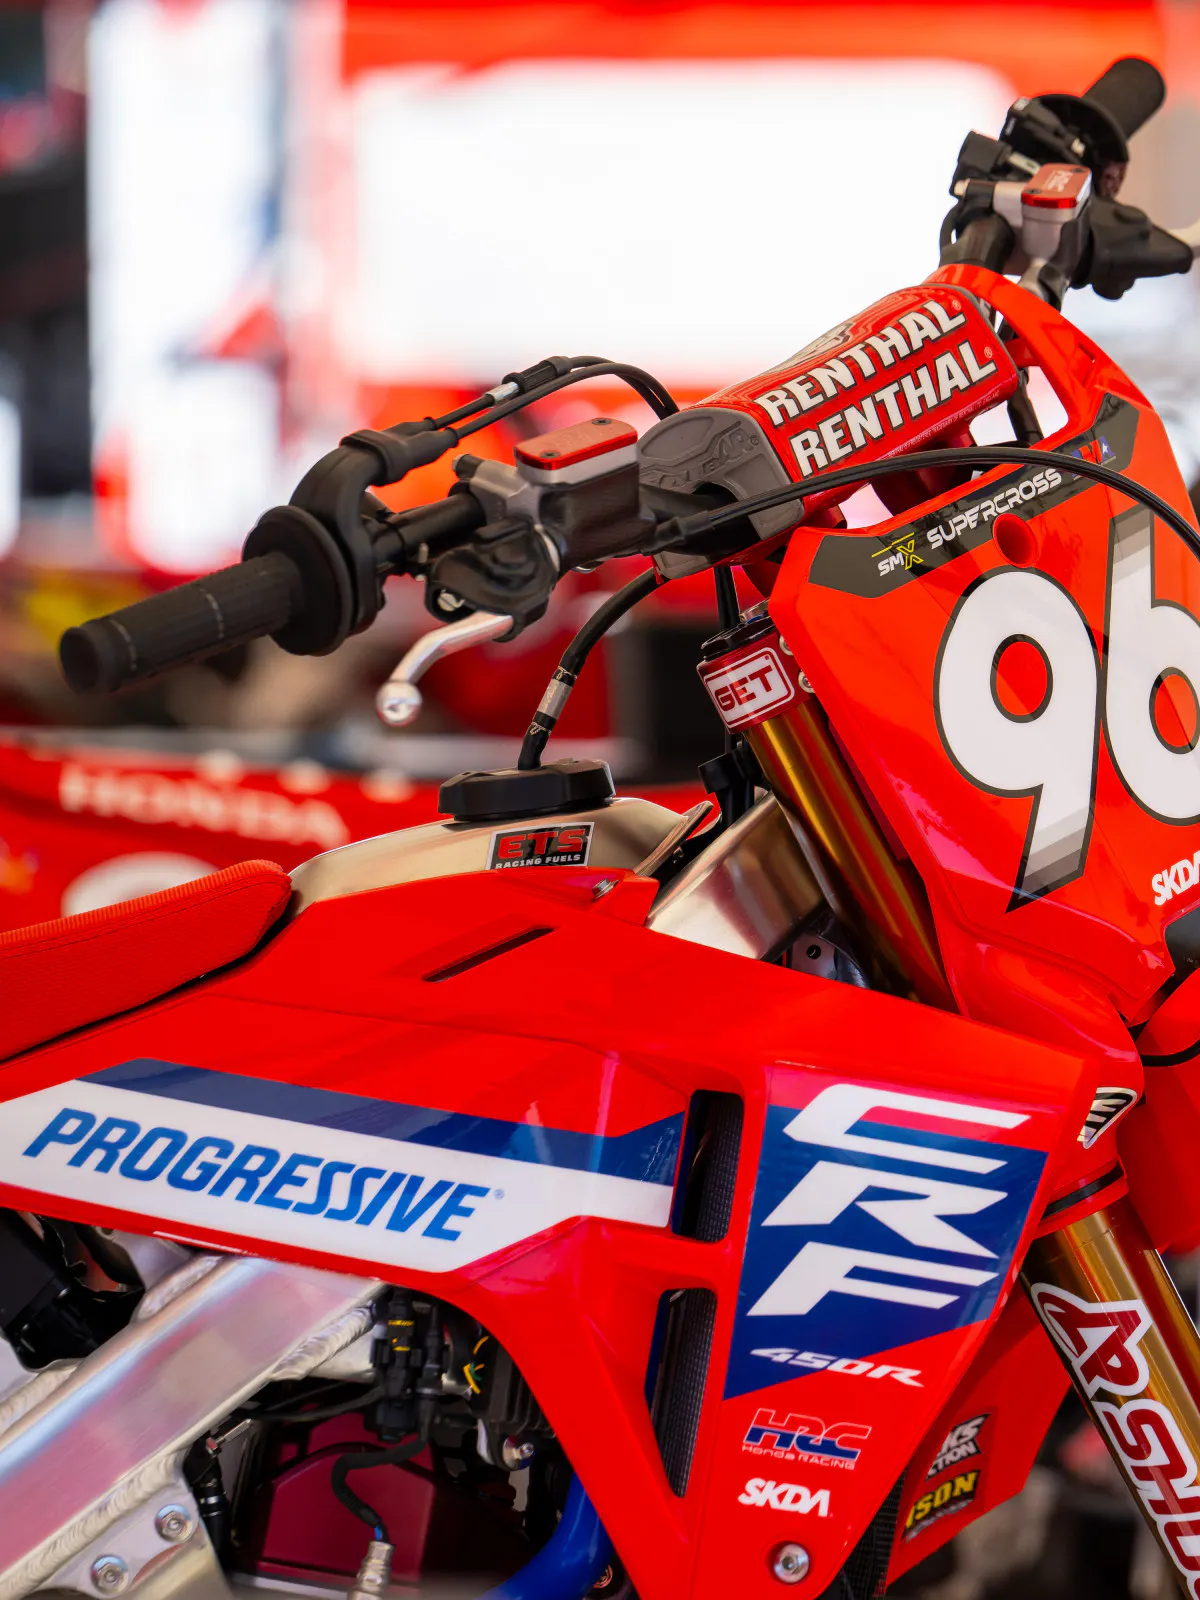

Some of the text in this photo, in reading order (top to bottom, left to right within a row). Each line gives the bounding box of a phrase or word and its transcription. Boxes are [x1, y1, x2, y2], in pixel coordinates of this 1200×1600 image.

[753, 299, 968, 429] RENTHAL
[788, 339, 999, 479] RENTHAL
[877, 468, 1062, 577] SMX SUPERCROSS
[714, 664, 773, 712] GET
[495, 854, 581, 870] RACING FUELS
[497, 828, 586, 859] ETS
[22, 1107, 492, 1243] PROGRESSIVE
[747, 1083, 1032, 1317] CRF
[750, 1347, 925, 1388] 450R
[743, 1407, 873, 1463] HRC
[797, 1453, 856, 1471] RACING
[738, 1477, 831, 1518] SKDA
